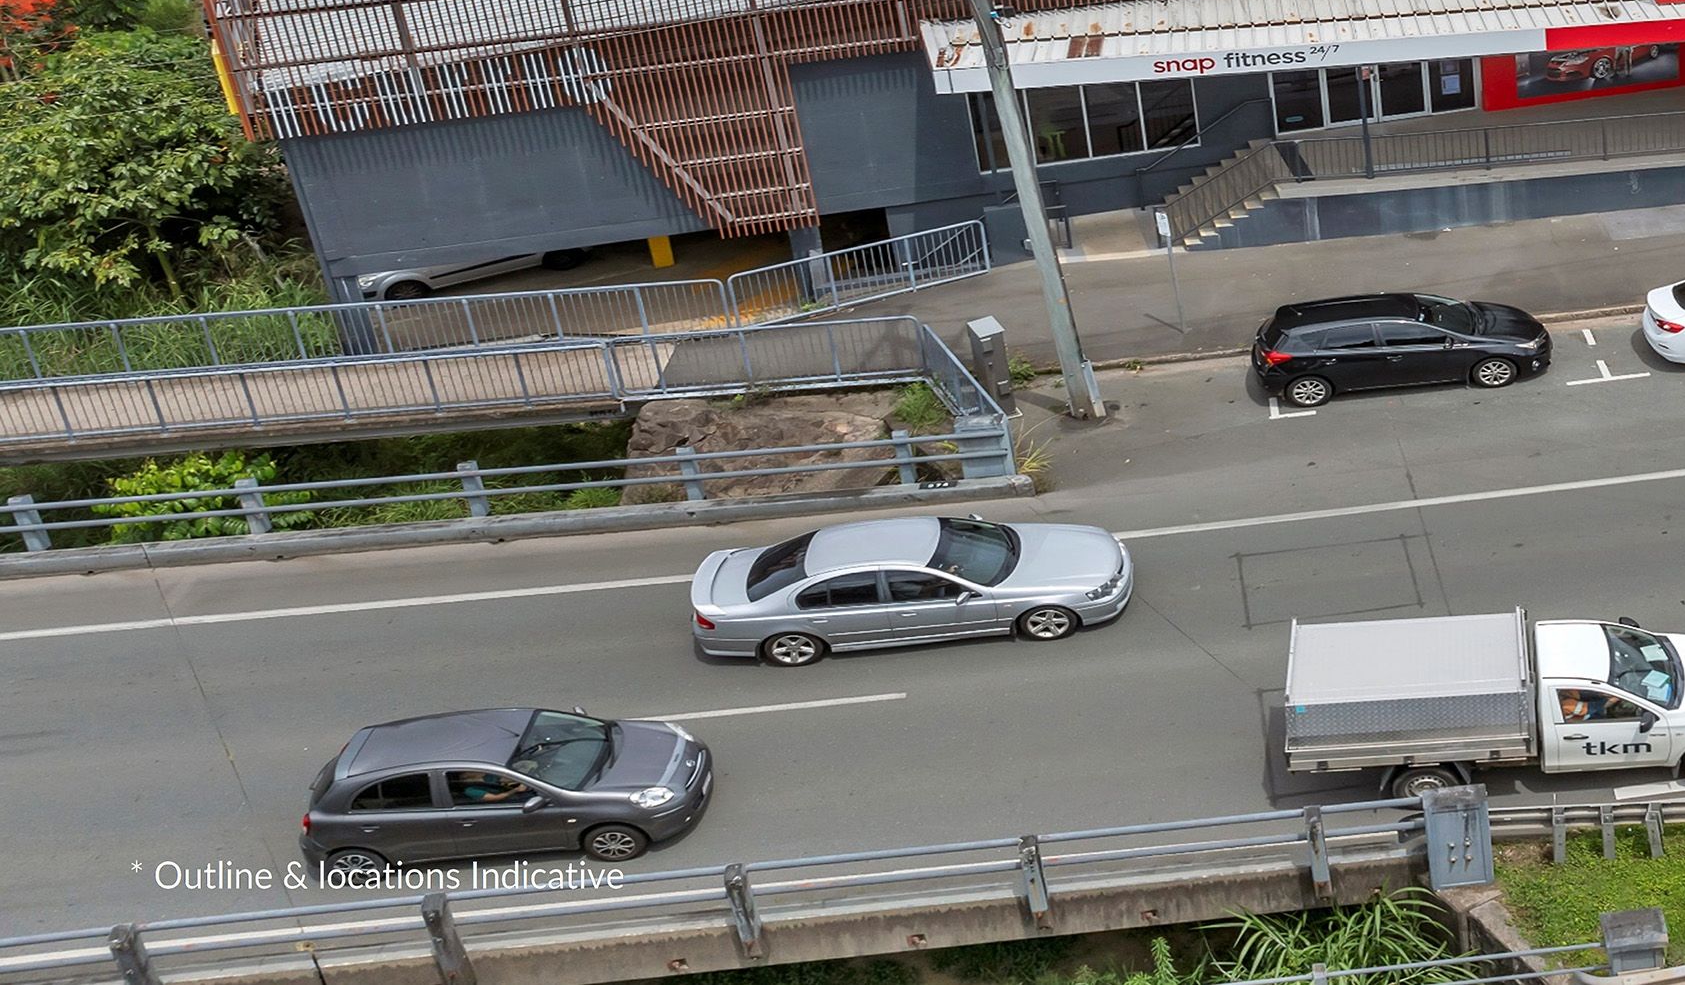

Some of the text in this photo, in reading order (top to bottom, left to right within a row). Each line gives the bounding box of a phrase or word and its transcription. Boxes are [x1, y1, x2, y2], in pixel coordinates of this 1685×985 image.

[1152, 44, 1340, 74] snap fitness 24/7
[1582, 741, 1652, 756] tkm
